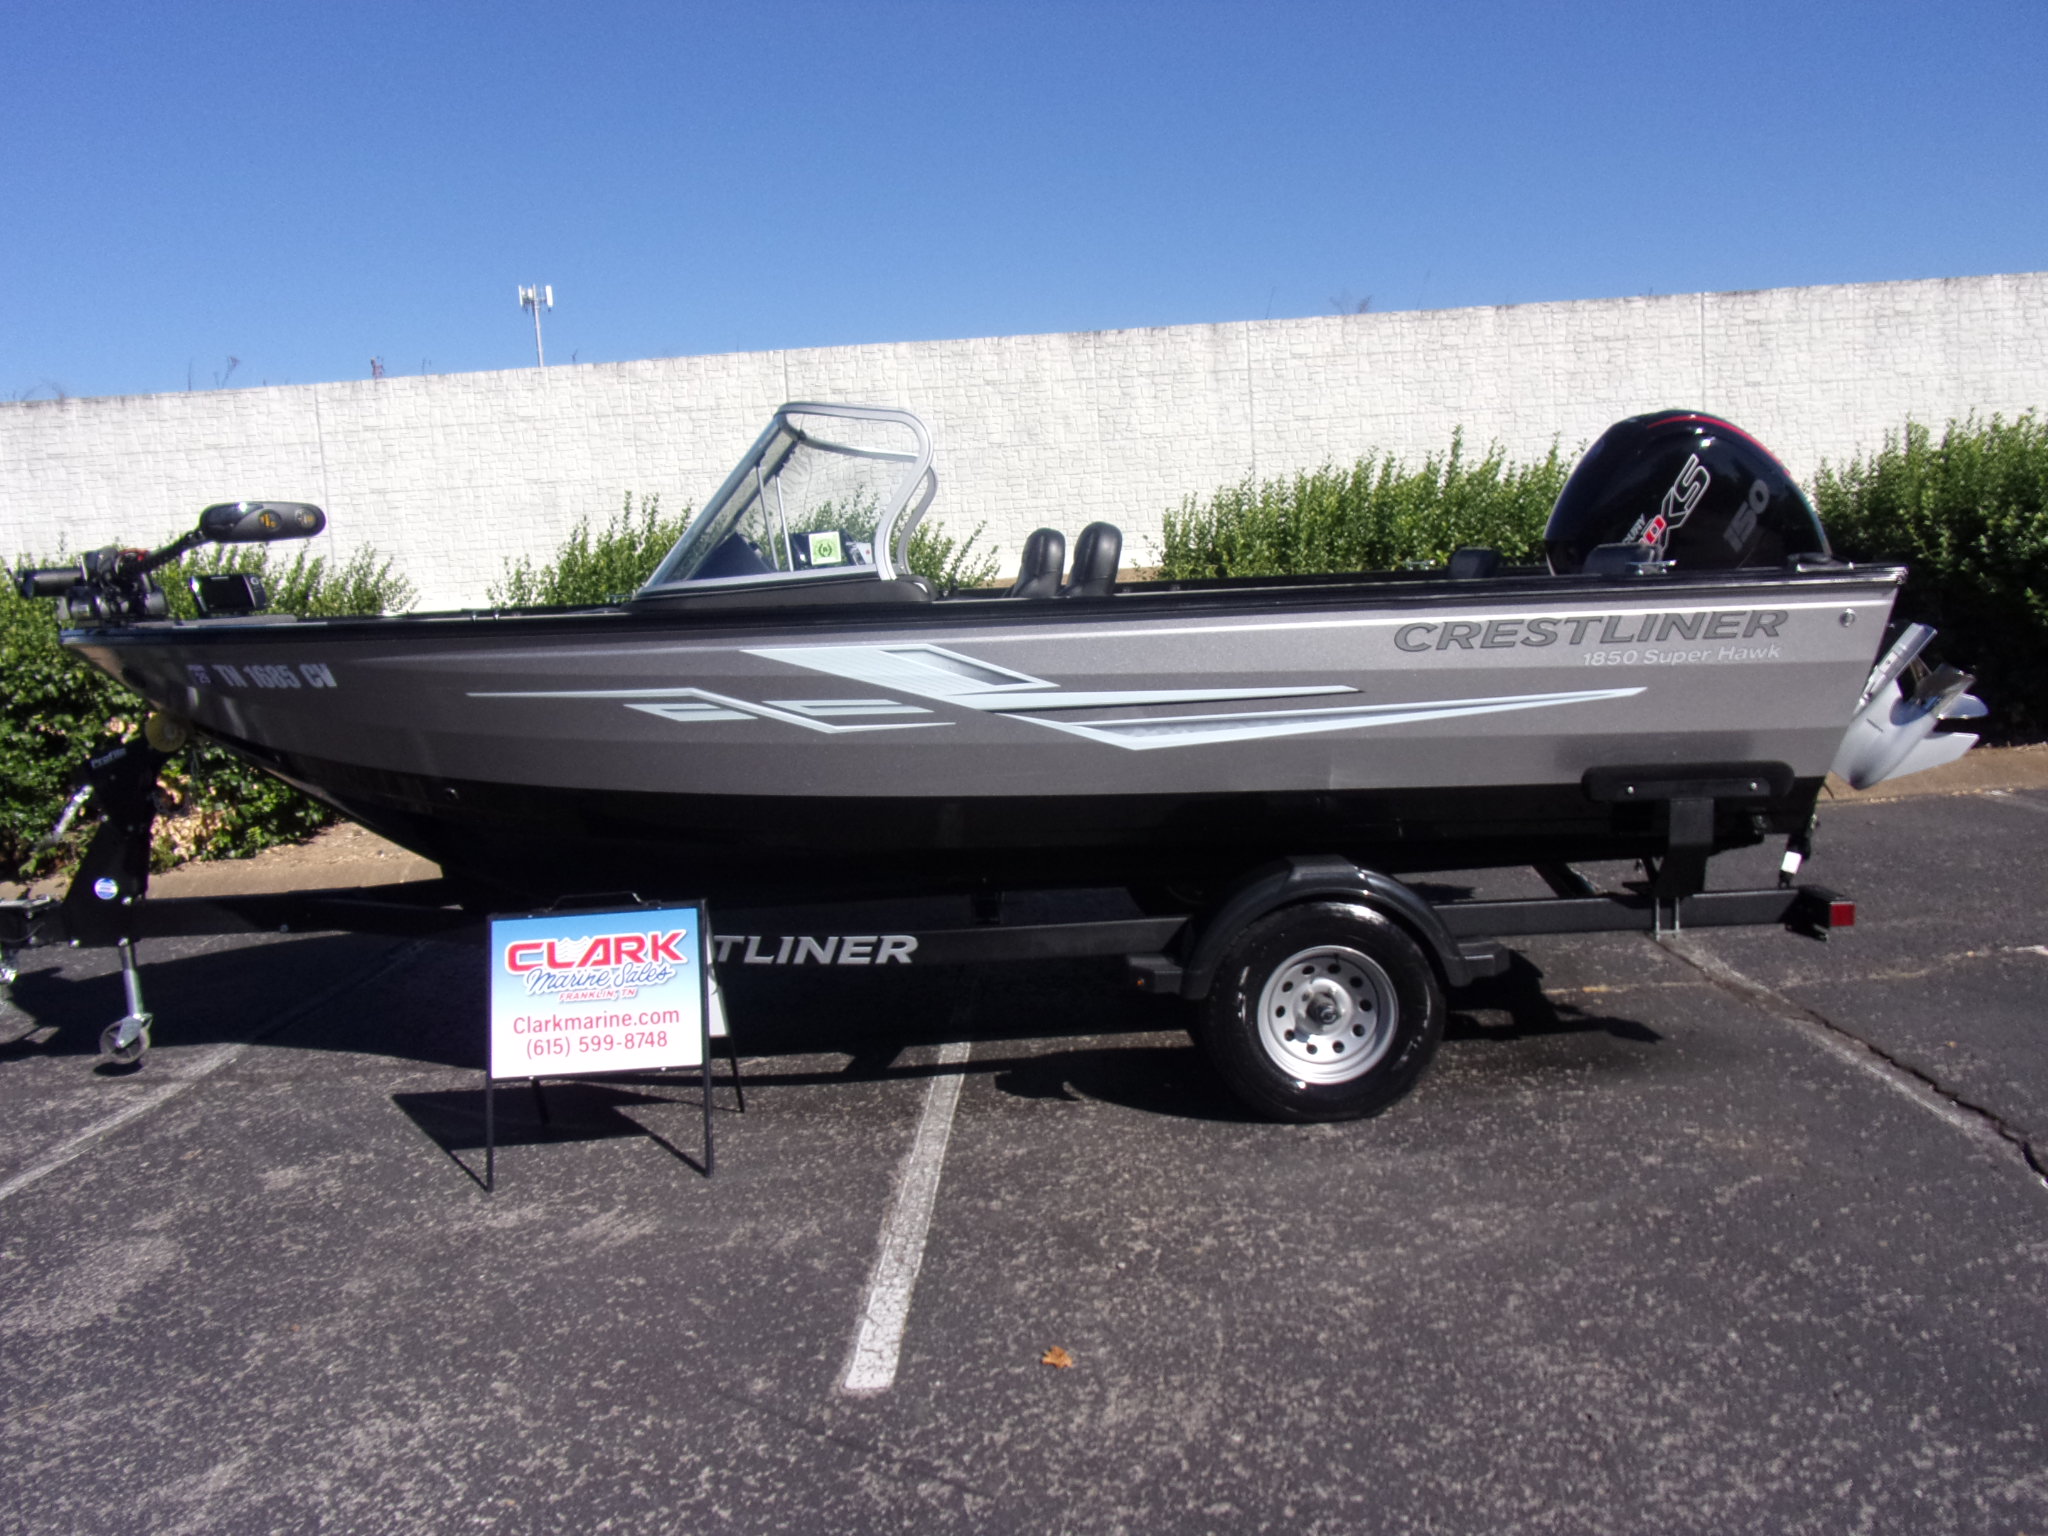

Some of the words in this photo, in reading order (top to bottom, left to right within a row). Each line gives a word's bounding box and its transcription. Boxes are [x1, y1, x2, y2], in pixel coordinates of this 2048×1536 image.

[1724, 479, 1770, 552] 150
[1393, 608, 1789, 652] CRESTLINER
[1583, 649, 1637, 667] 1850
[1643, 648, 1711, 667] Super
[1717, 644, 1782, 661] Hawk
[211, 663, 248, 688] TN
[242, 664, 301, 688] 1685
[507, 931, 687, 972] CLARK
[714, 934, 919, 965] TLINER
[526, 968, 611, 993] Marine
[615, 961, 672, 988] Sales
[559, 988, 616, 1002] FRANKLIN,
[621, 987, 637, 997] TN
[513, 1009, 680, 1034] Clarkmarine.com
[526, 1036, 571, 1060] (615)
[578, 1031, 668, 1053] 599-8748
